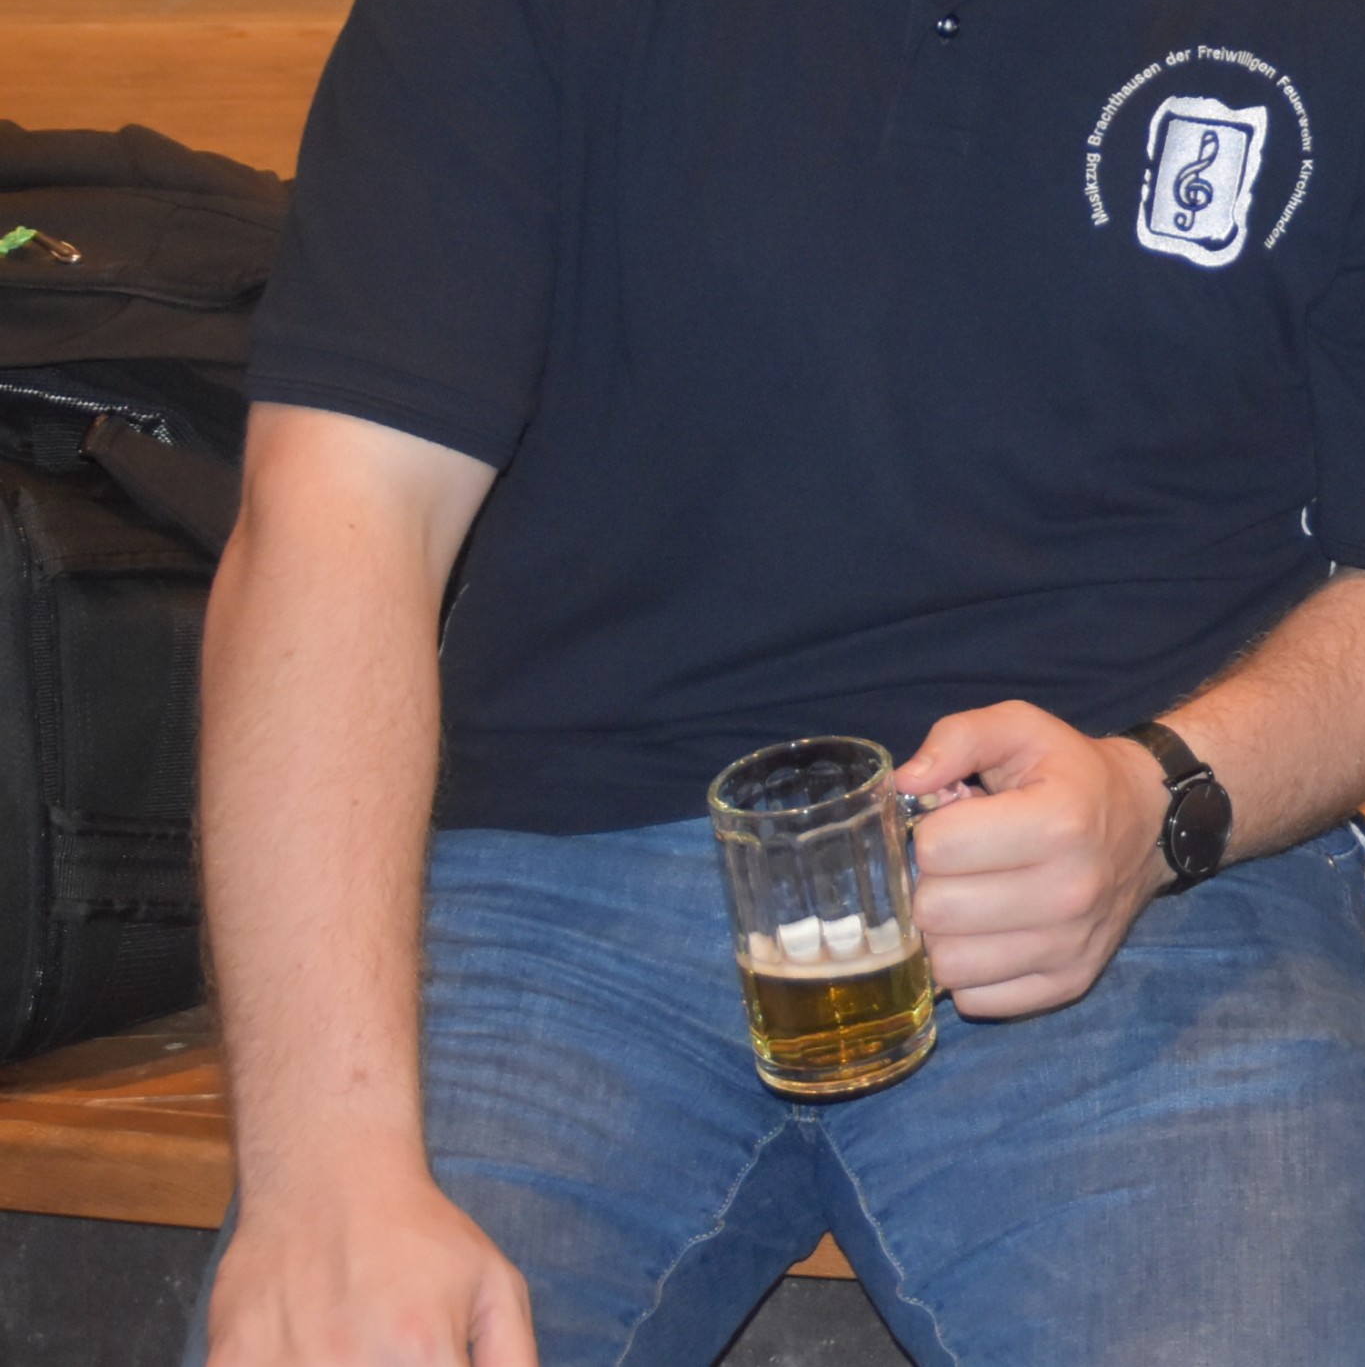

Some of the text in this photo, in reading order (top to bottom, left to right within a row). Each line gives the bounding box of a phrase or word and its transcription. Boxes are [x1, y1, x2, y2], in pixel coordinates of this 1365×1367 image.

[1084, 45, 1314, 250] Musikzug Brachthausen der Freiwilligen Feuerwehr Kirchhundem
